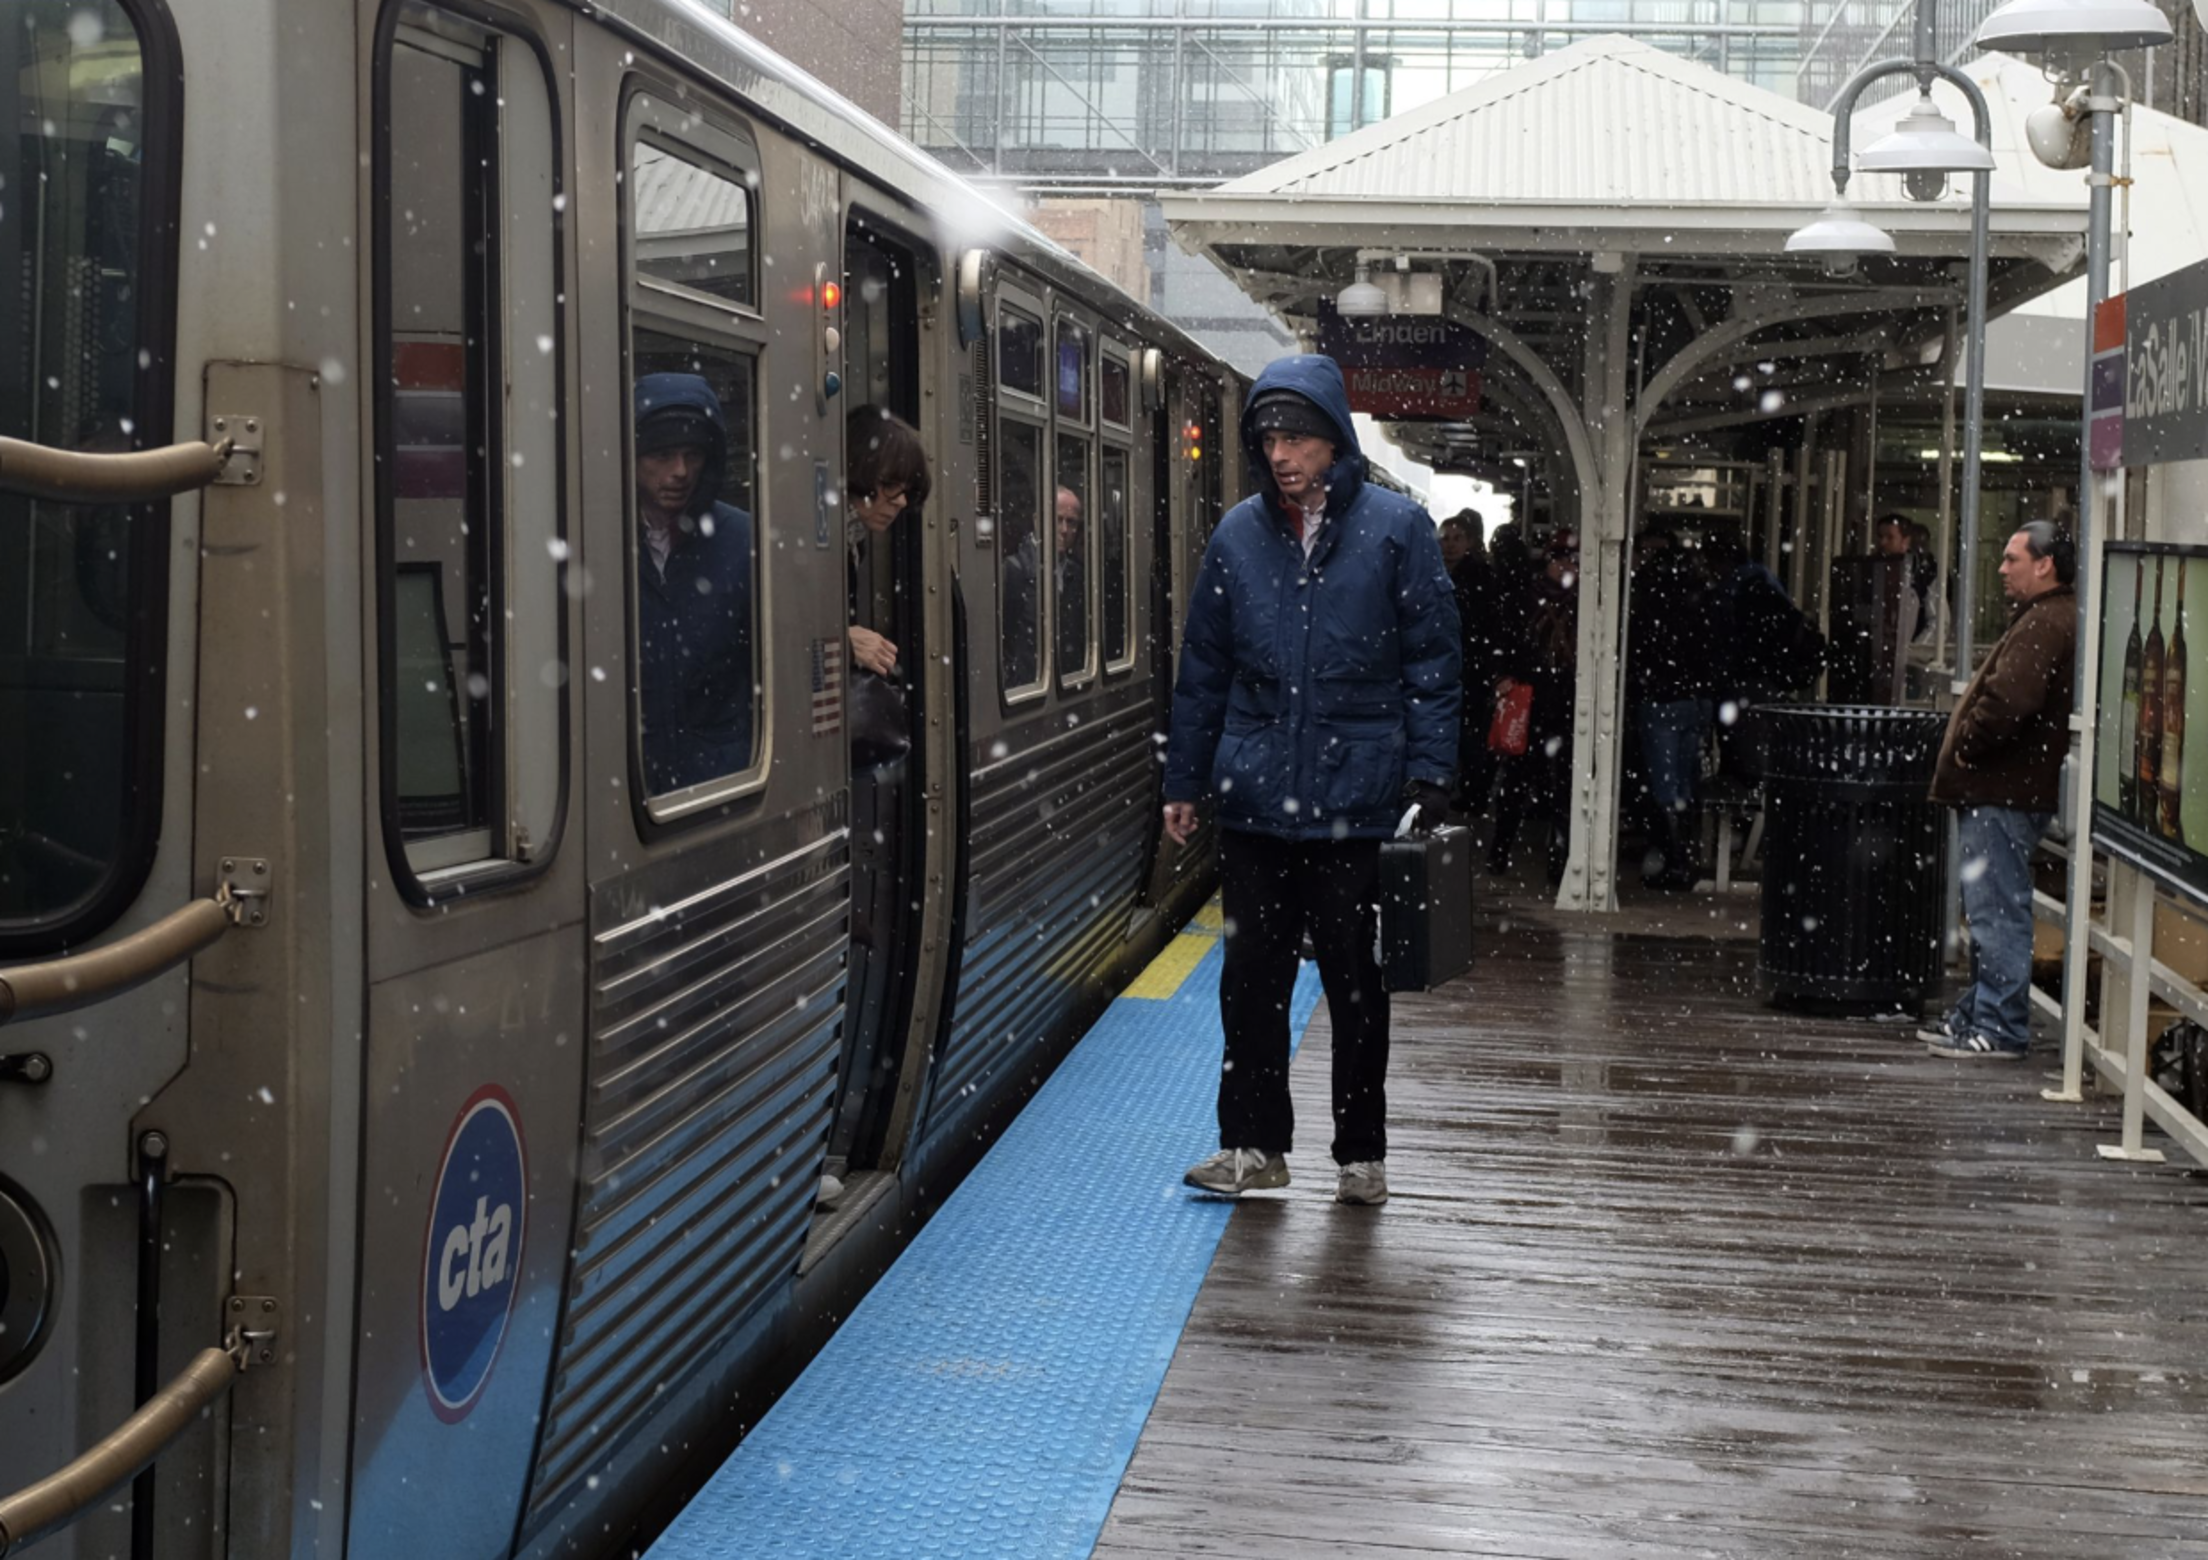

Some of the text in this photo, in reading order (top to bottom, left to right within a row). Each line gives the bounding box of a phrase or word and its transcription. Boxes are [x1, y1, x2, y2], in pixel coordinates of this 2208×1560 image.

[1356, 324, 1446, 344] Linden
[2127, 308, 2208, 419] LaSalle/V
[1352, 373, 1436, 397] Midway
[438, 1195, 512, 1311] cta
